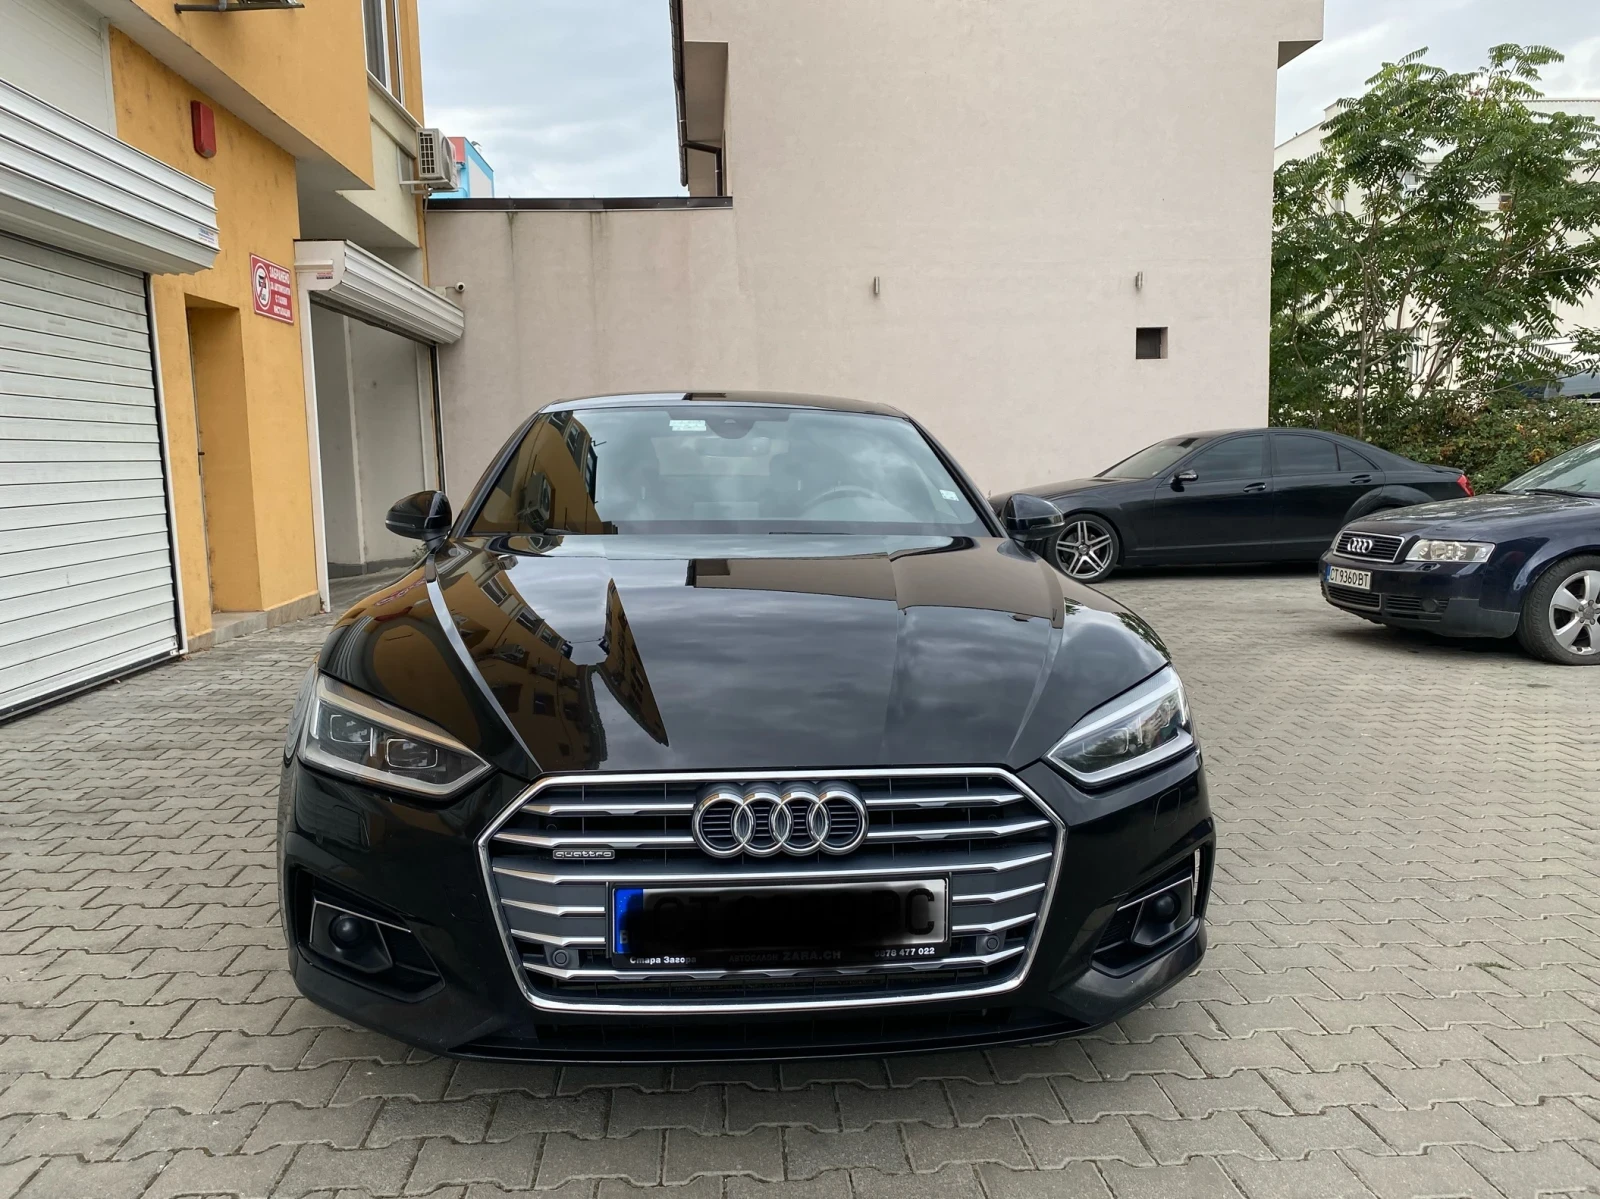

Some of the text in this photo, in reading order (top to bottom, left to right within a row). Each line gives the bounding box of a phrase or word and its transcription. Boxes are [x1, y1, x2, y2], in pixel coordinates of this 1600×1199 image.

[555, 850, 612, 858] quattro
[899, 948, 916, 956] 477
[918, 947, 935, 955] 022
